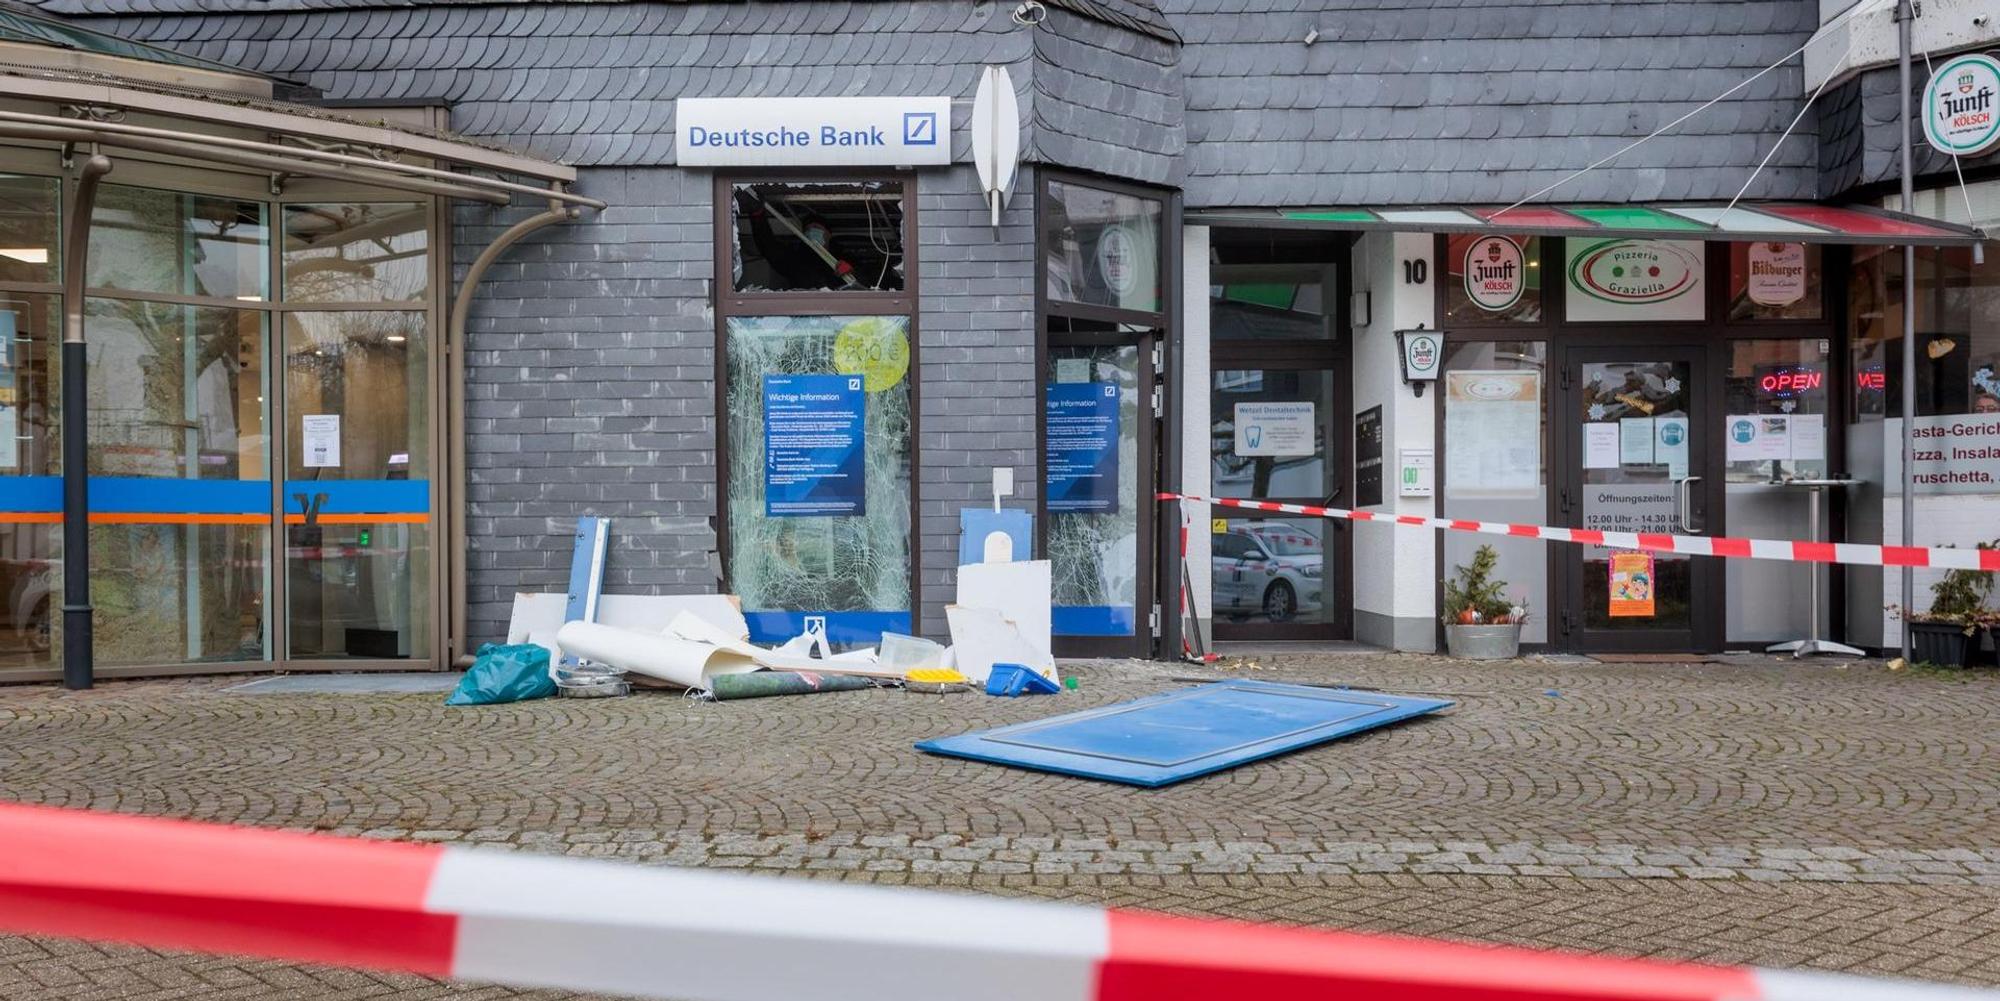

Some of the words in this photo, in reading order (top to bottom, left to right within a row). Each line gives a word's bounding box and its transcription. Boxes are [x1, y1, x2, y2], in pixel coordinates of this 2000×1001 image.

[1939, 86, 1994, 120] Zunft
[1953, 112, 1989, 128] KÖLSCH
[689, 125, 810, 147] Deutsche
[821, 125, 885, 147] Bank
[1614, 250, 1658, 262] Pizzeria
[1403, 258, 1427, 285] 10
[1473, 259, 1516, 283] Zunft
[1752, 260, 1802, 277] Bitburger
[1484, 280, 1513, 291] KÖLSCH
[1609, 282, 1665, 295] Graziella
[1762, 373, 1821, 390] OPEN
[768, 394, 799, 402] Wichtige
[800, 393, 840, 401] Information
[1912, 422, 2000, 438] asta-Geric
[1912, 449, 1947, 462] izza,
[1913, 471, 1994, 484] ruschetta,
[1598, 493, 1675, 505] Öffnungszeiten:
[1587, 515, 1612, 523] 12.00
[1614, 515, 1632, 523] Uhr
[1641, 515, 1666, 523] 14.30
[1668, 515, 1681, 523] Uh
